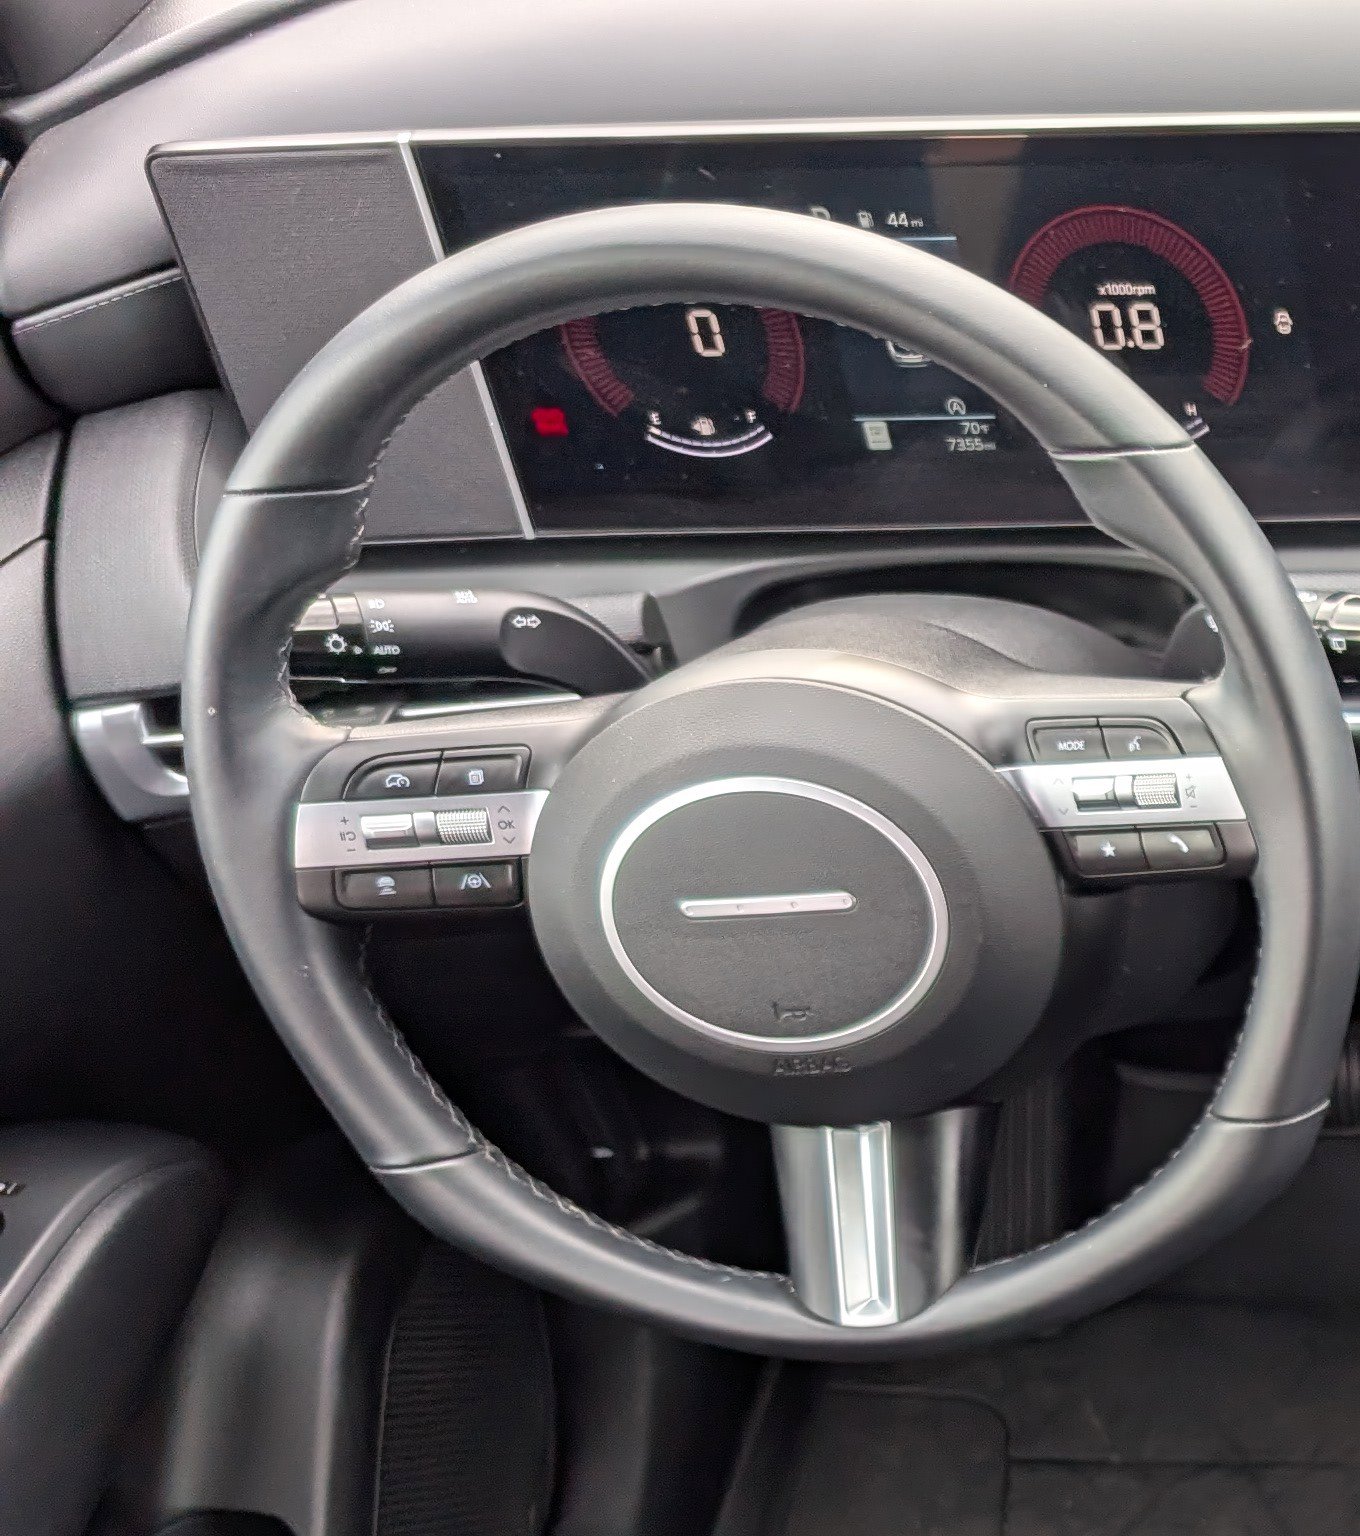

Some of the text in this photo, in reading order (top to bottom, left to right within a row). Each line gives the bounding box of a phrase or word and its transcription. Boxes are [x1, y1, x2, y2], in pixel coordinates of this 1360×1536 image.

[885, 212, 908, 228] 44
[686, 307, 725, 357] 0
[1090, 302, 1165, 350] 0.8
